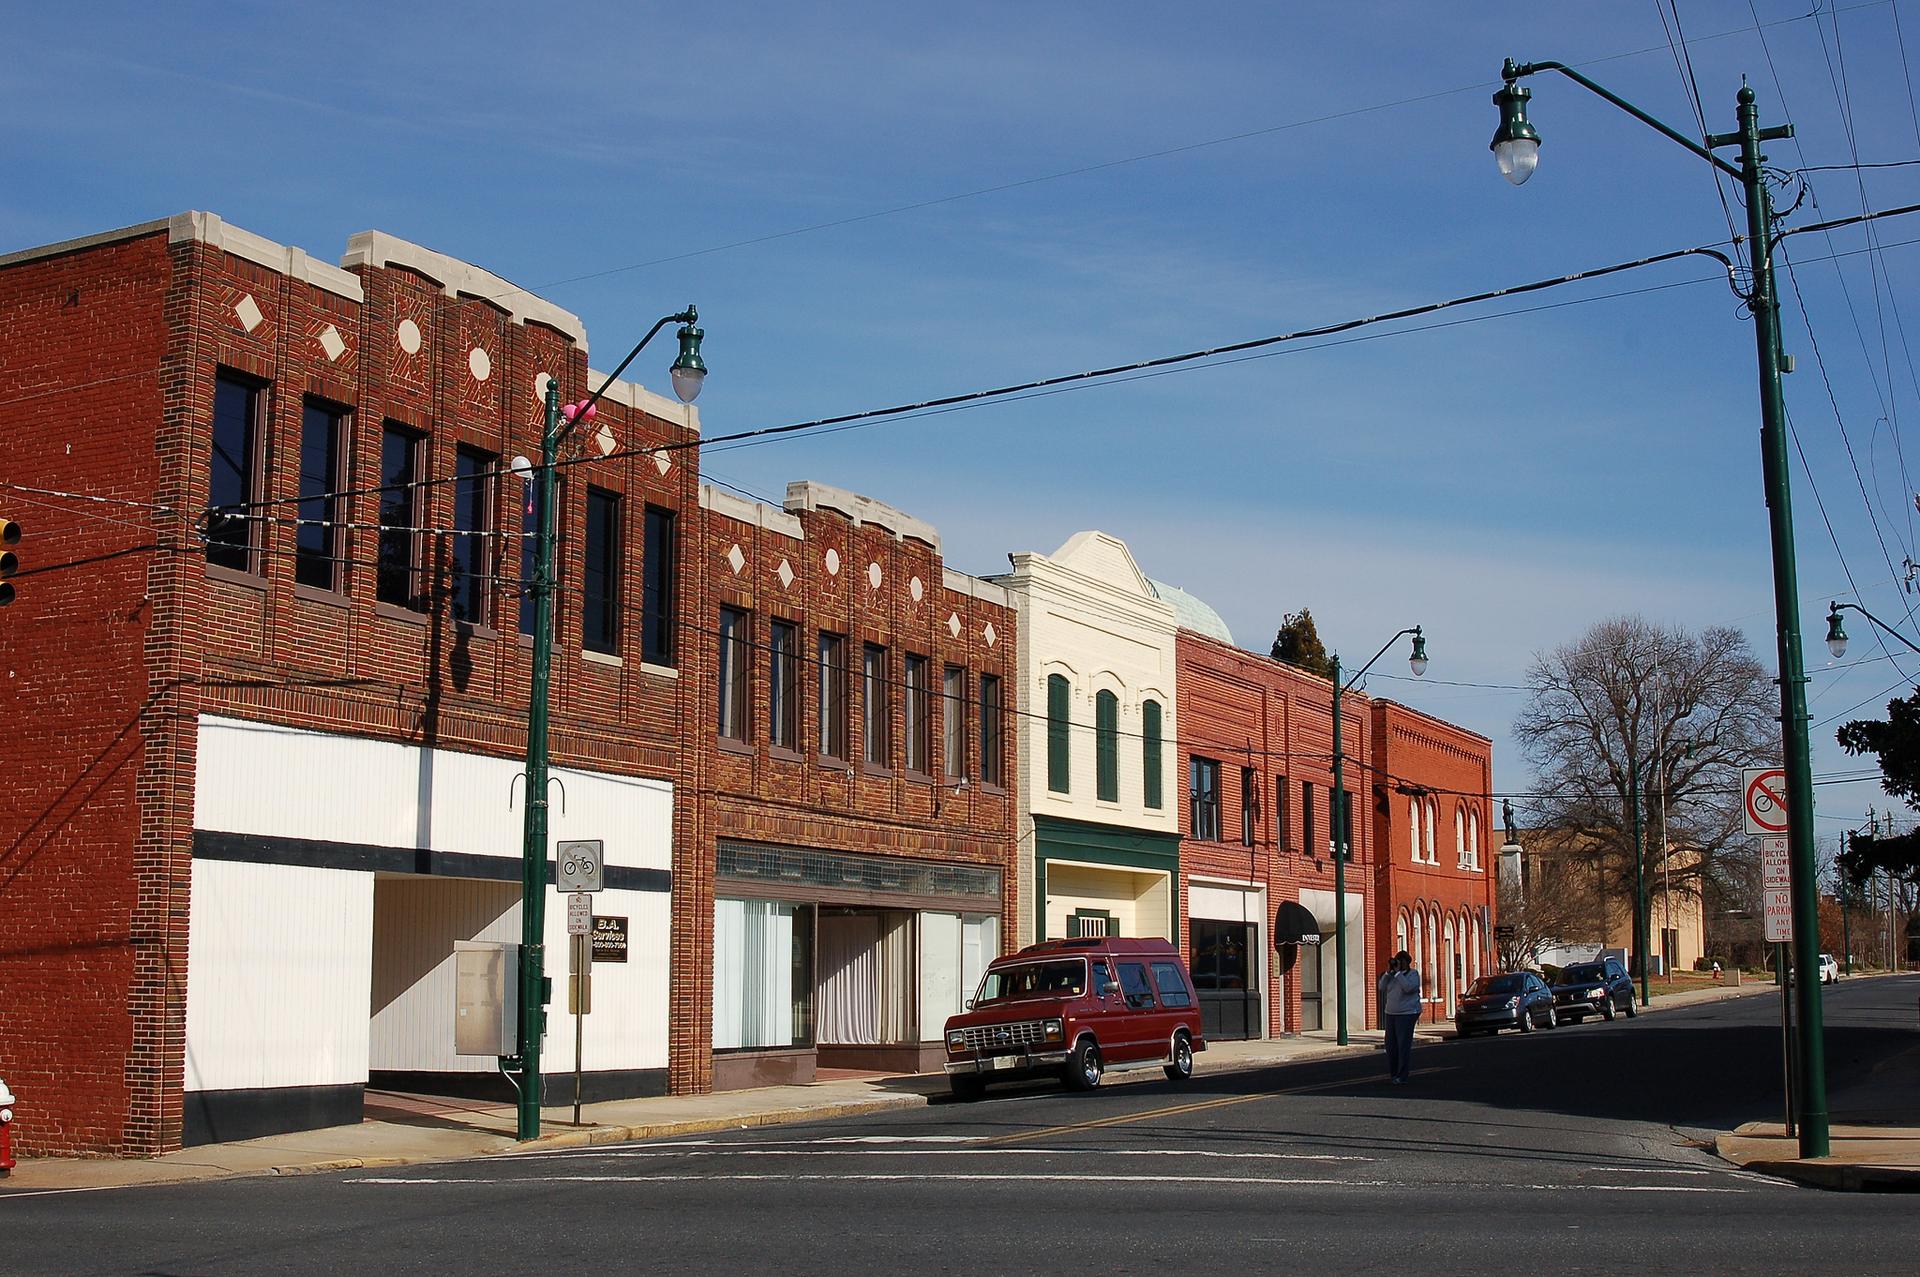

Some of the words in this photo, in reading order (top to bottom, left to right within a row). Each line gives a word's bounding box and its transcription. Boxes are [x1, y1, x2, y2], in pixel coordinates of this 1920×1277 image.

[1774, 840, 1785, 849] NO
[1765, 850, 1788, 858] BICYCL
[1776, 867, 1785, 875] ON
[1765, 876, 1790, 884] SIDEWAL
[1775, 894, 1788, 904] NO
[1767, 905, 1791, 916] PARKIN
[1776, 919, 1790, 928] ANY
[592, 930, 625, 941] Services
[1776, 928, 1790, 936] TIME
